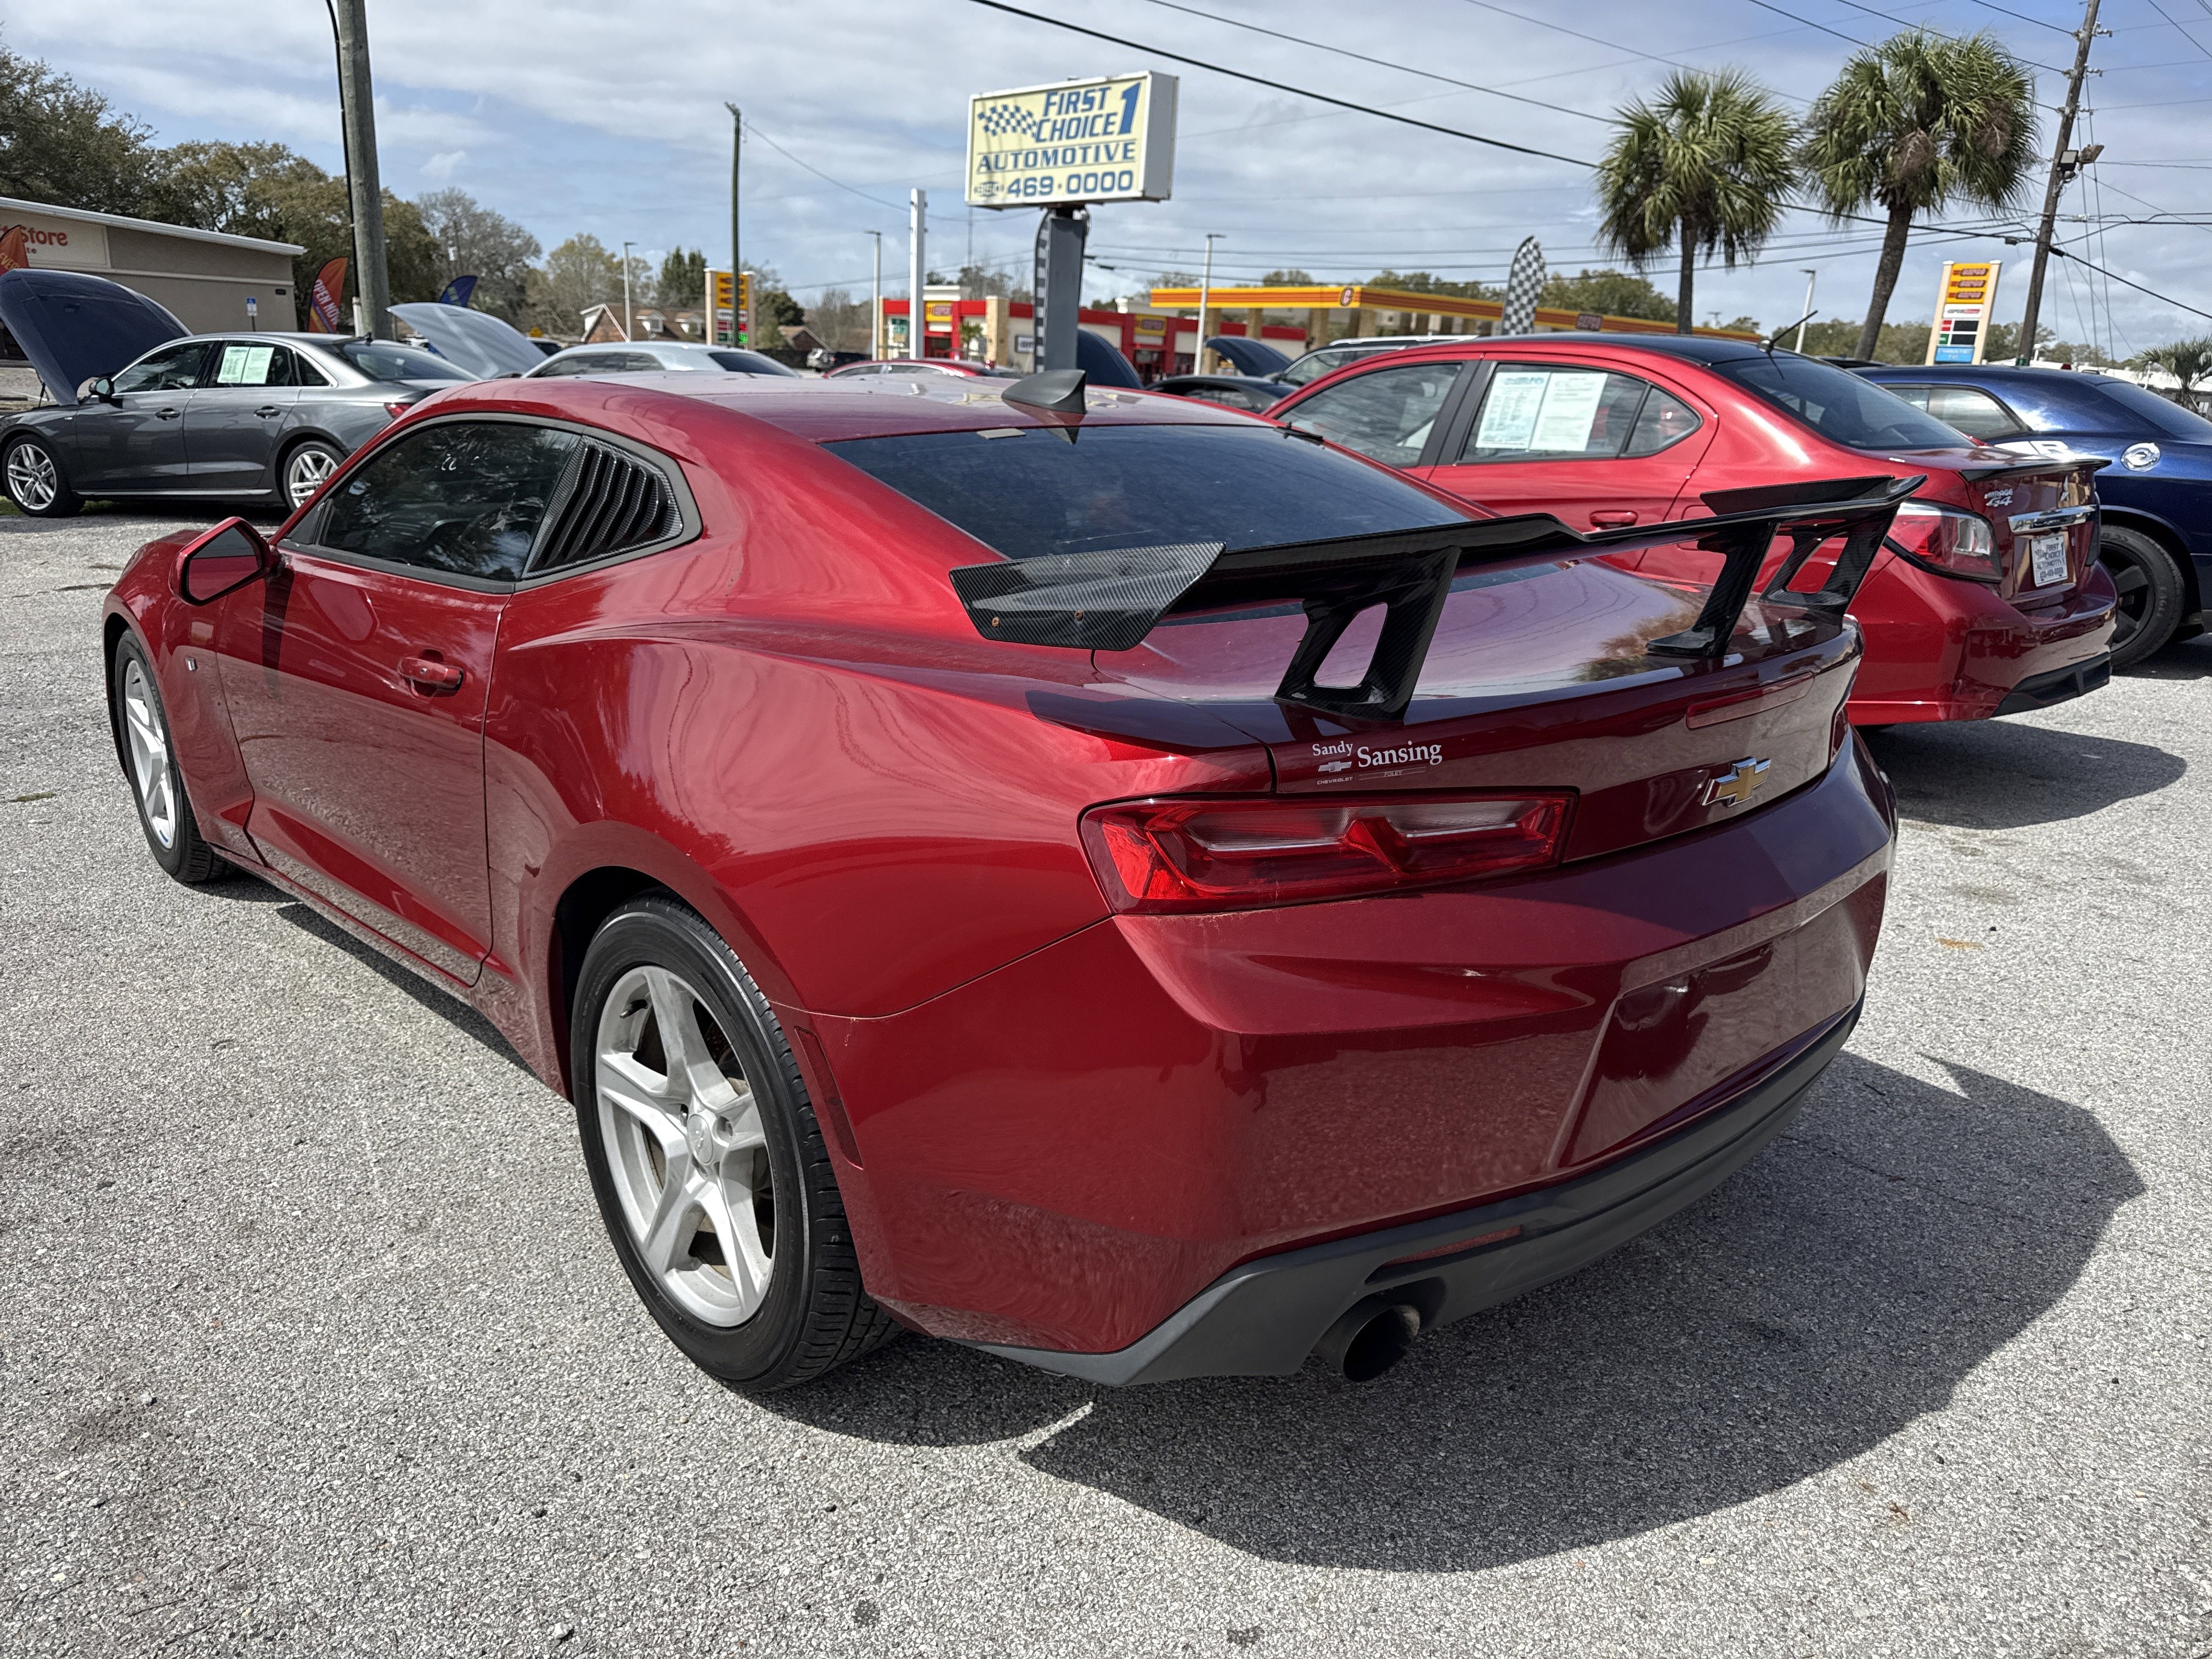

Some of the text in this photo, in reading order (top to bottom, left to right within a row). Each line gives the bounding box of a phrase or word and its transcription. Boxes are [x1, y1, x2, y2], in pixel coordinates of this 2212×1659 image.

[1043, 86, 1111, 117] FIRST
[1118, 82, 1142, 136] 1
[1035, 112, 1118, 143] CHOICE
[977, 141, 1137, 173] AUTOMOTIVE
[313, 279, 332, 305] OPEN
[1985, 496, 2013, 507] G4
[1312, 740, 1443, 768] Sandy Sansing
[1317, 776, 1353, 785] CHEVROLET
